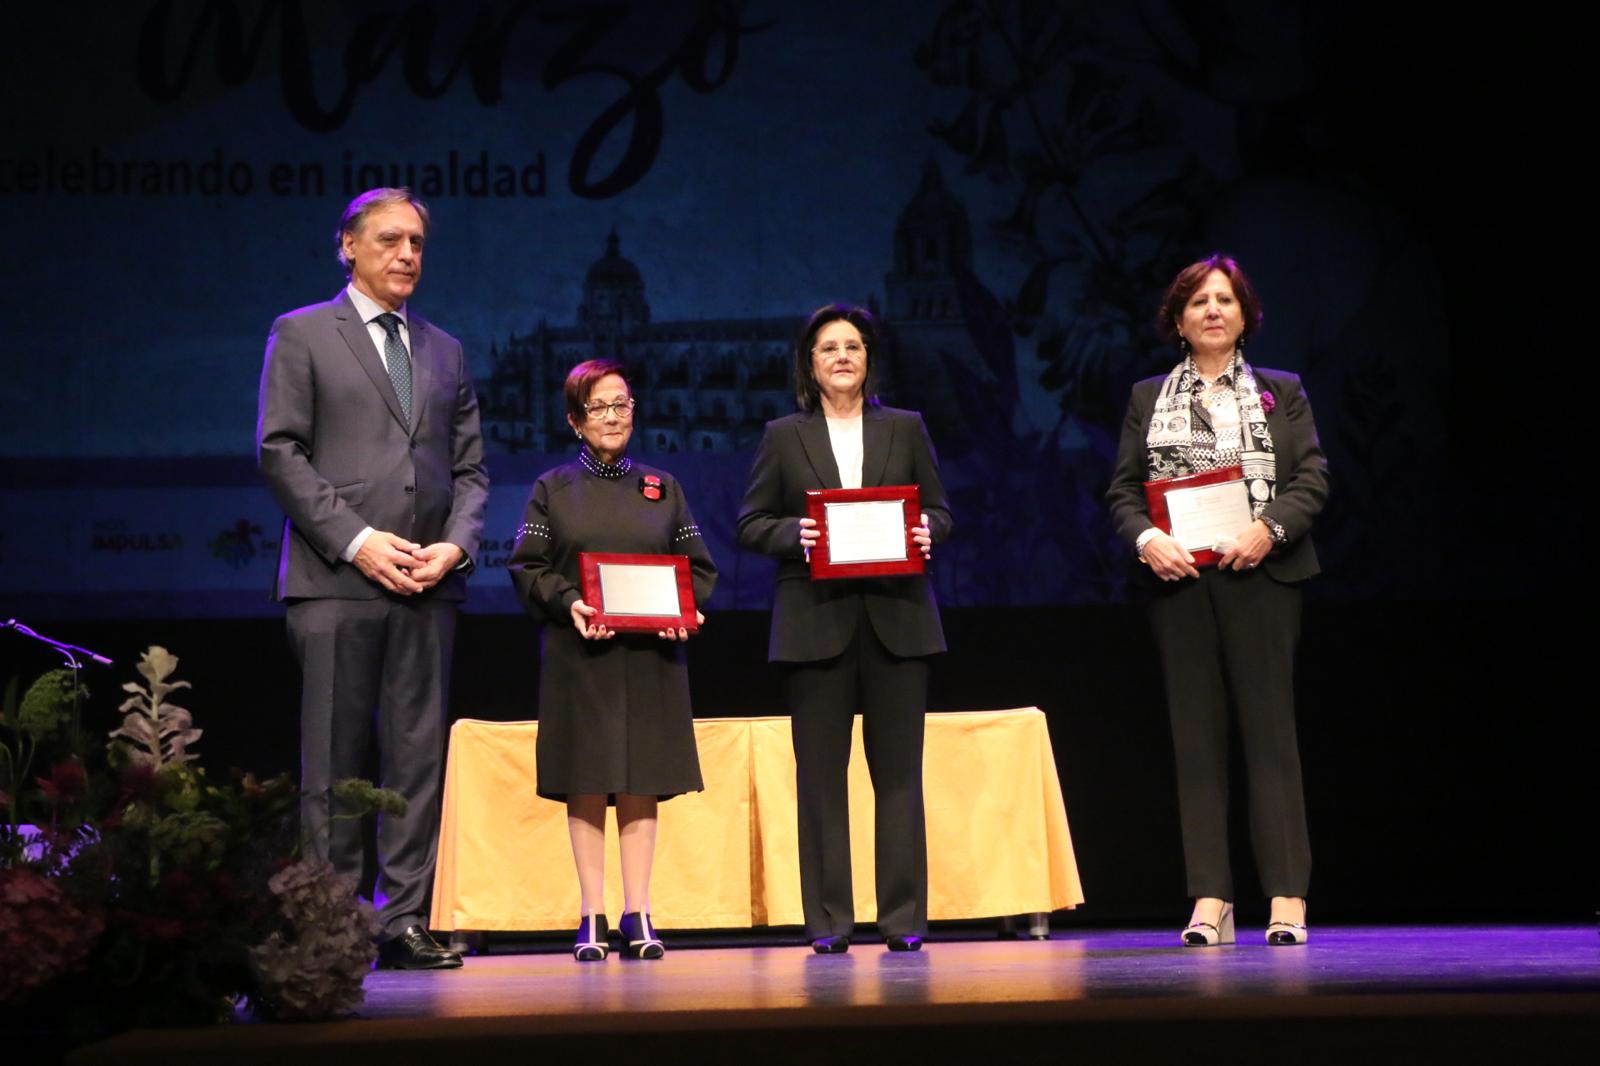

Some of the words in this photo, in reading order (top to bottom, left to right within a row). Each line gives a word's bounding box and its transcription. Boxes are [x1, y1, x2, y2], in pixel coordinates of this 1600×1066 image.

[136, 0, 777, 198] Marzo
[269, 161, 325, 197] en
[344, 150, 548, 197] igualdad
